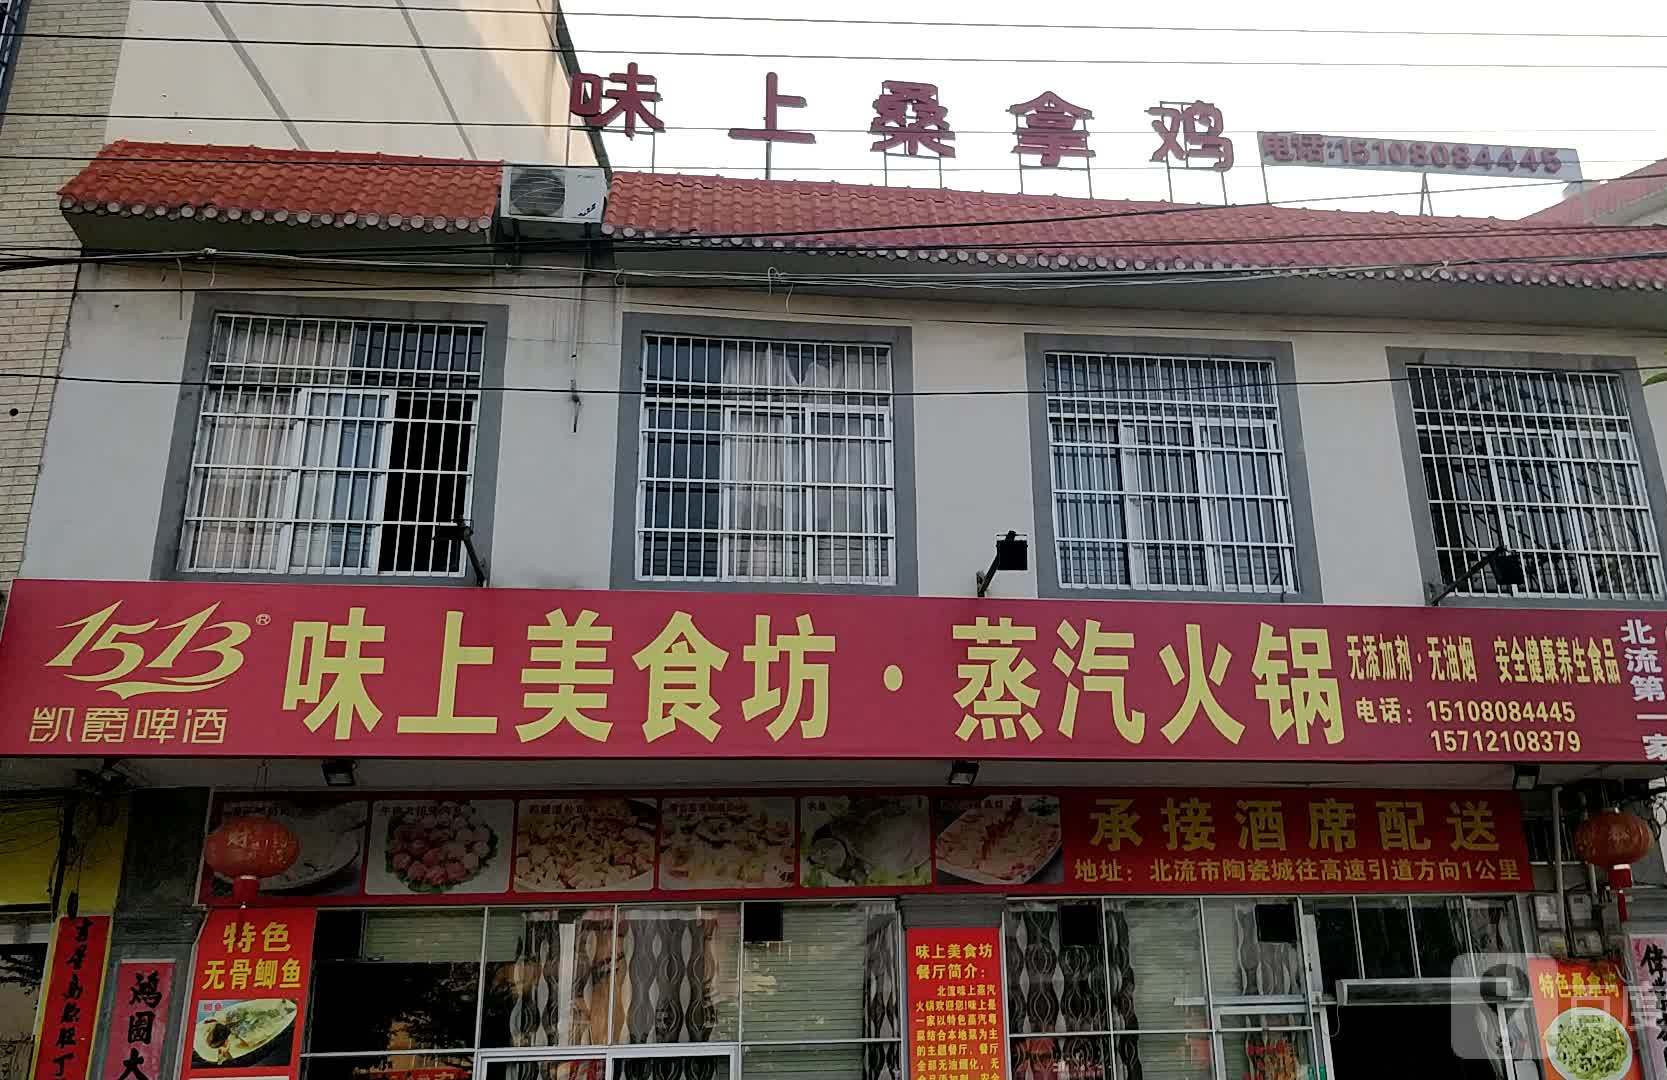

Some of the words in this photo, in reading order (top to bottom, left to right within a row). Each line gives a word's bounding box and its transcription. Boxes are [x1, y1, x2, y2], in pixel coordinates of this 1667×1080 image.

[570, 62, 1234, 171] 味上桑拿鸡
[1494, 635, 1622, 686] 安全健康养生食品
[1620, 619, 1667, 761] 北流第一家
[29, 706, 228, 745] 凯爵啤酒
[1430, 730, 1581, 753] 15712108379
[1089, 798, 1500, 853] 承接酒席配送
[222, 921, 291, 953] 特色
[915, 943, 993, 959] 味上美食坊
[202, 957, 302, 991] 无骨鲫鱼
